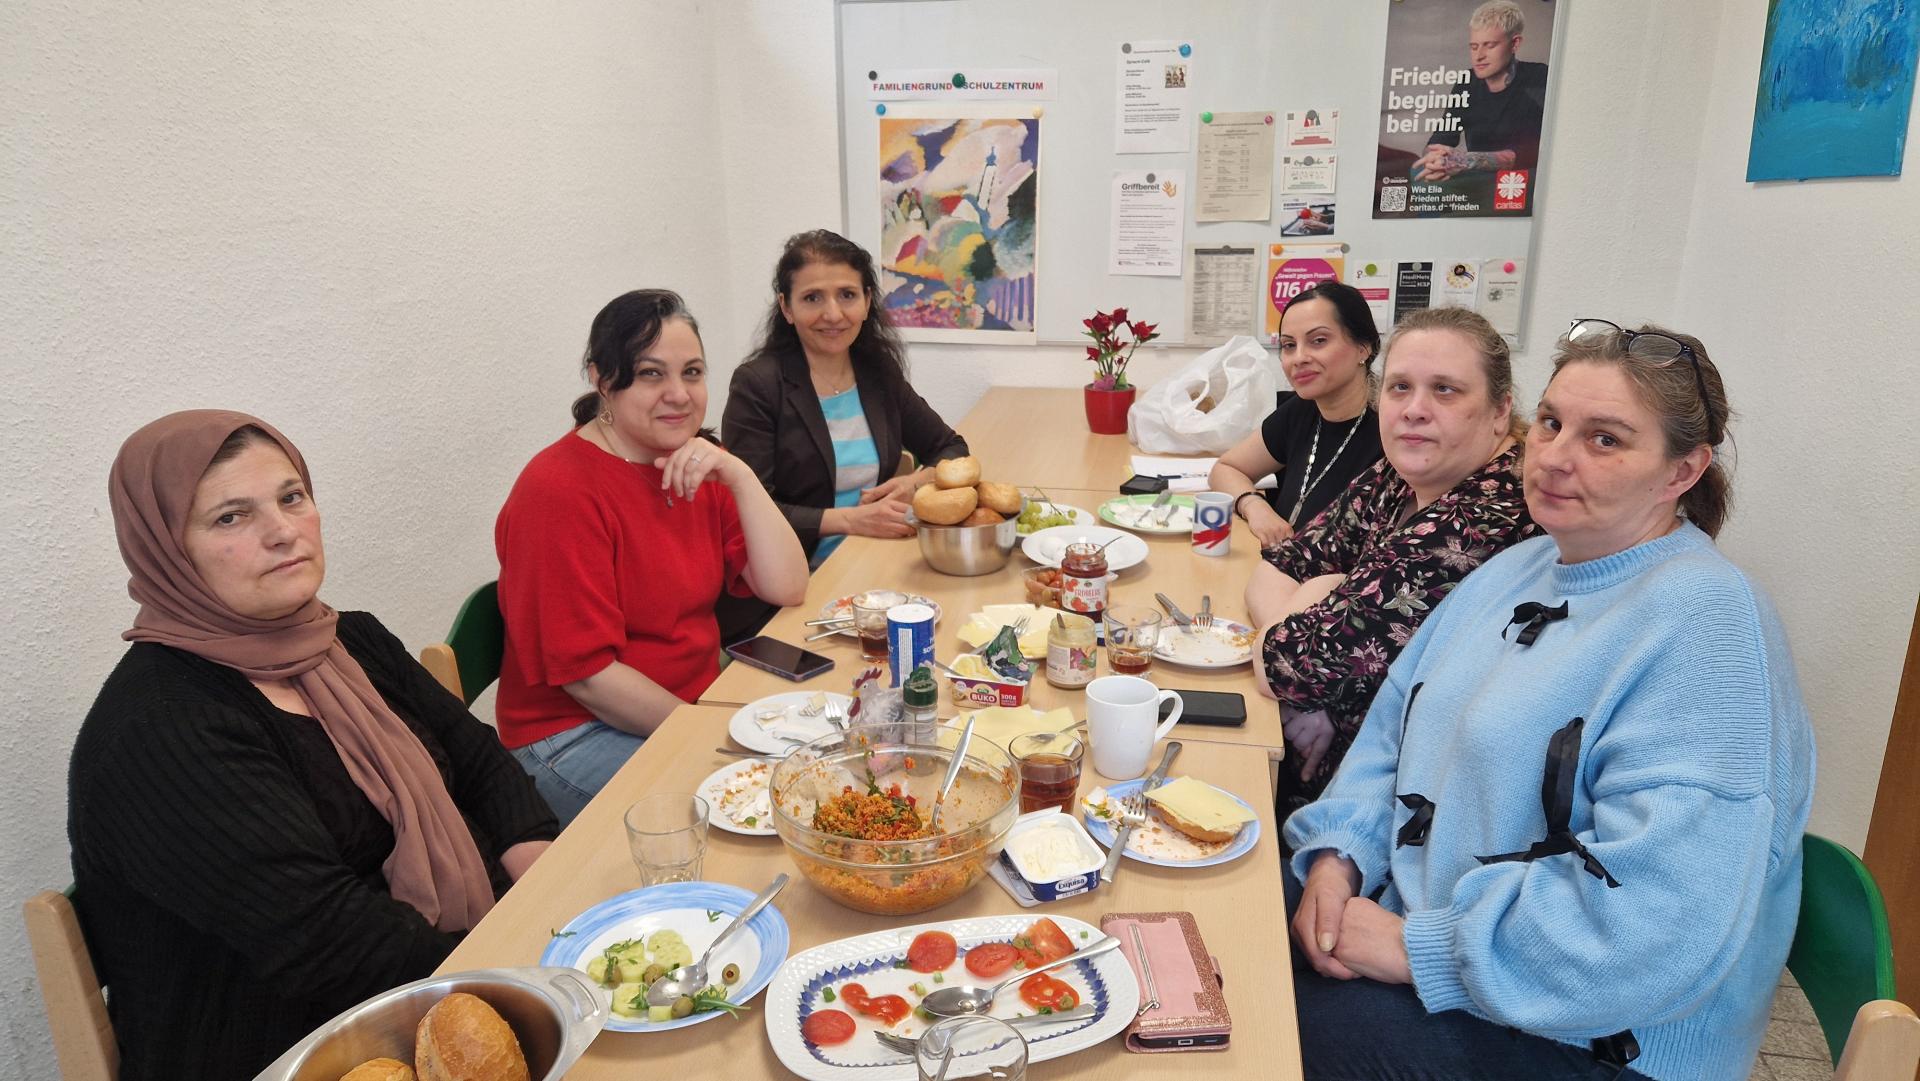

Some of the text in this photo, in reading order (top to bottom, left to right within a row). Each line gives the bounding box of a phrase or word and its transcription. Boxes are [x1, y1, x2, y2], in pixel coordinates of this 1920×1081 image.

[1390, 65, 1471, 87] Frieden
[873, 81, 1044, 91] FAMILIENGRUND SCHULZENTRUM
[1388, 90, 1470, 114] beginnt
[1386, 112, 1464, 133] bei mir.
[1121, 183, 1160, 191] Griffbereit
[1411, 185, 1443, 194] Wie Elia
[1410, 194, 1440, 203] Frieden
[1495, 201, 1523, 210] caritas
[1274, 281, 1301, 299] 116
[970, 693, 996, 703] BUKO
[1059, 879, 1085, 889] Exquisa
